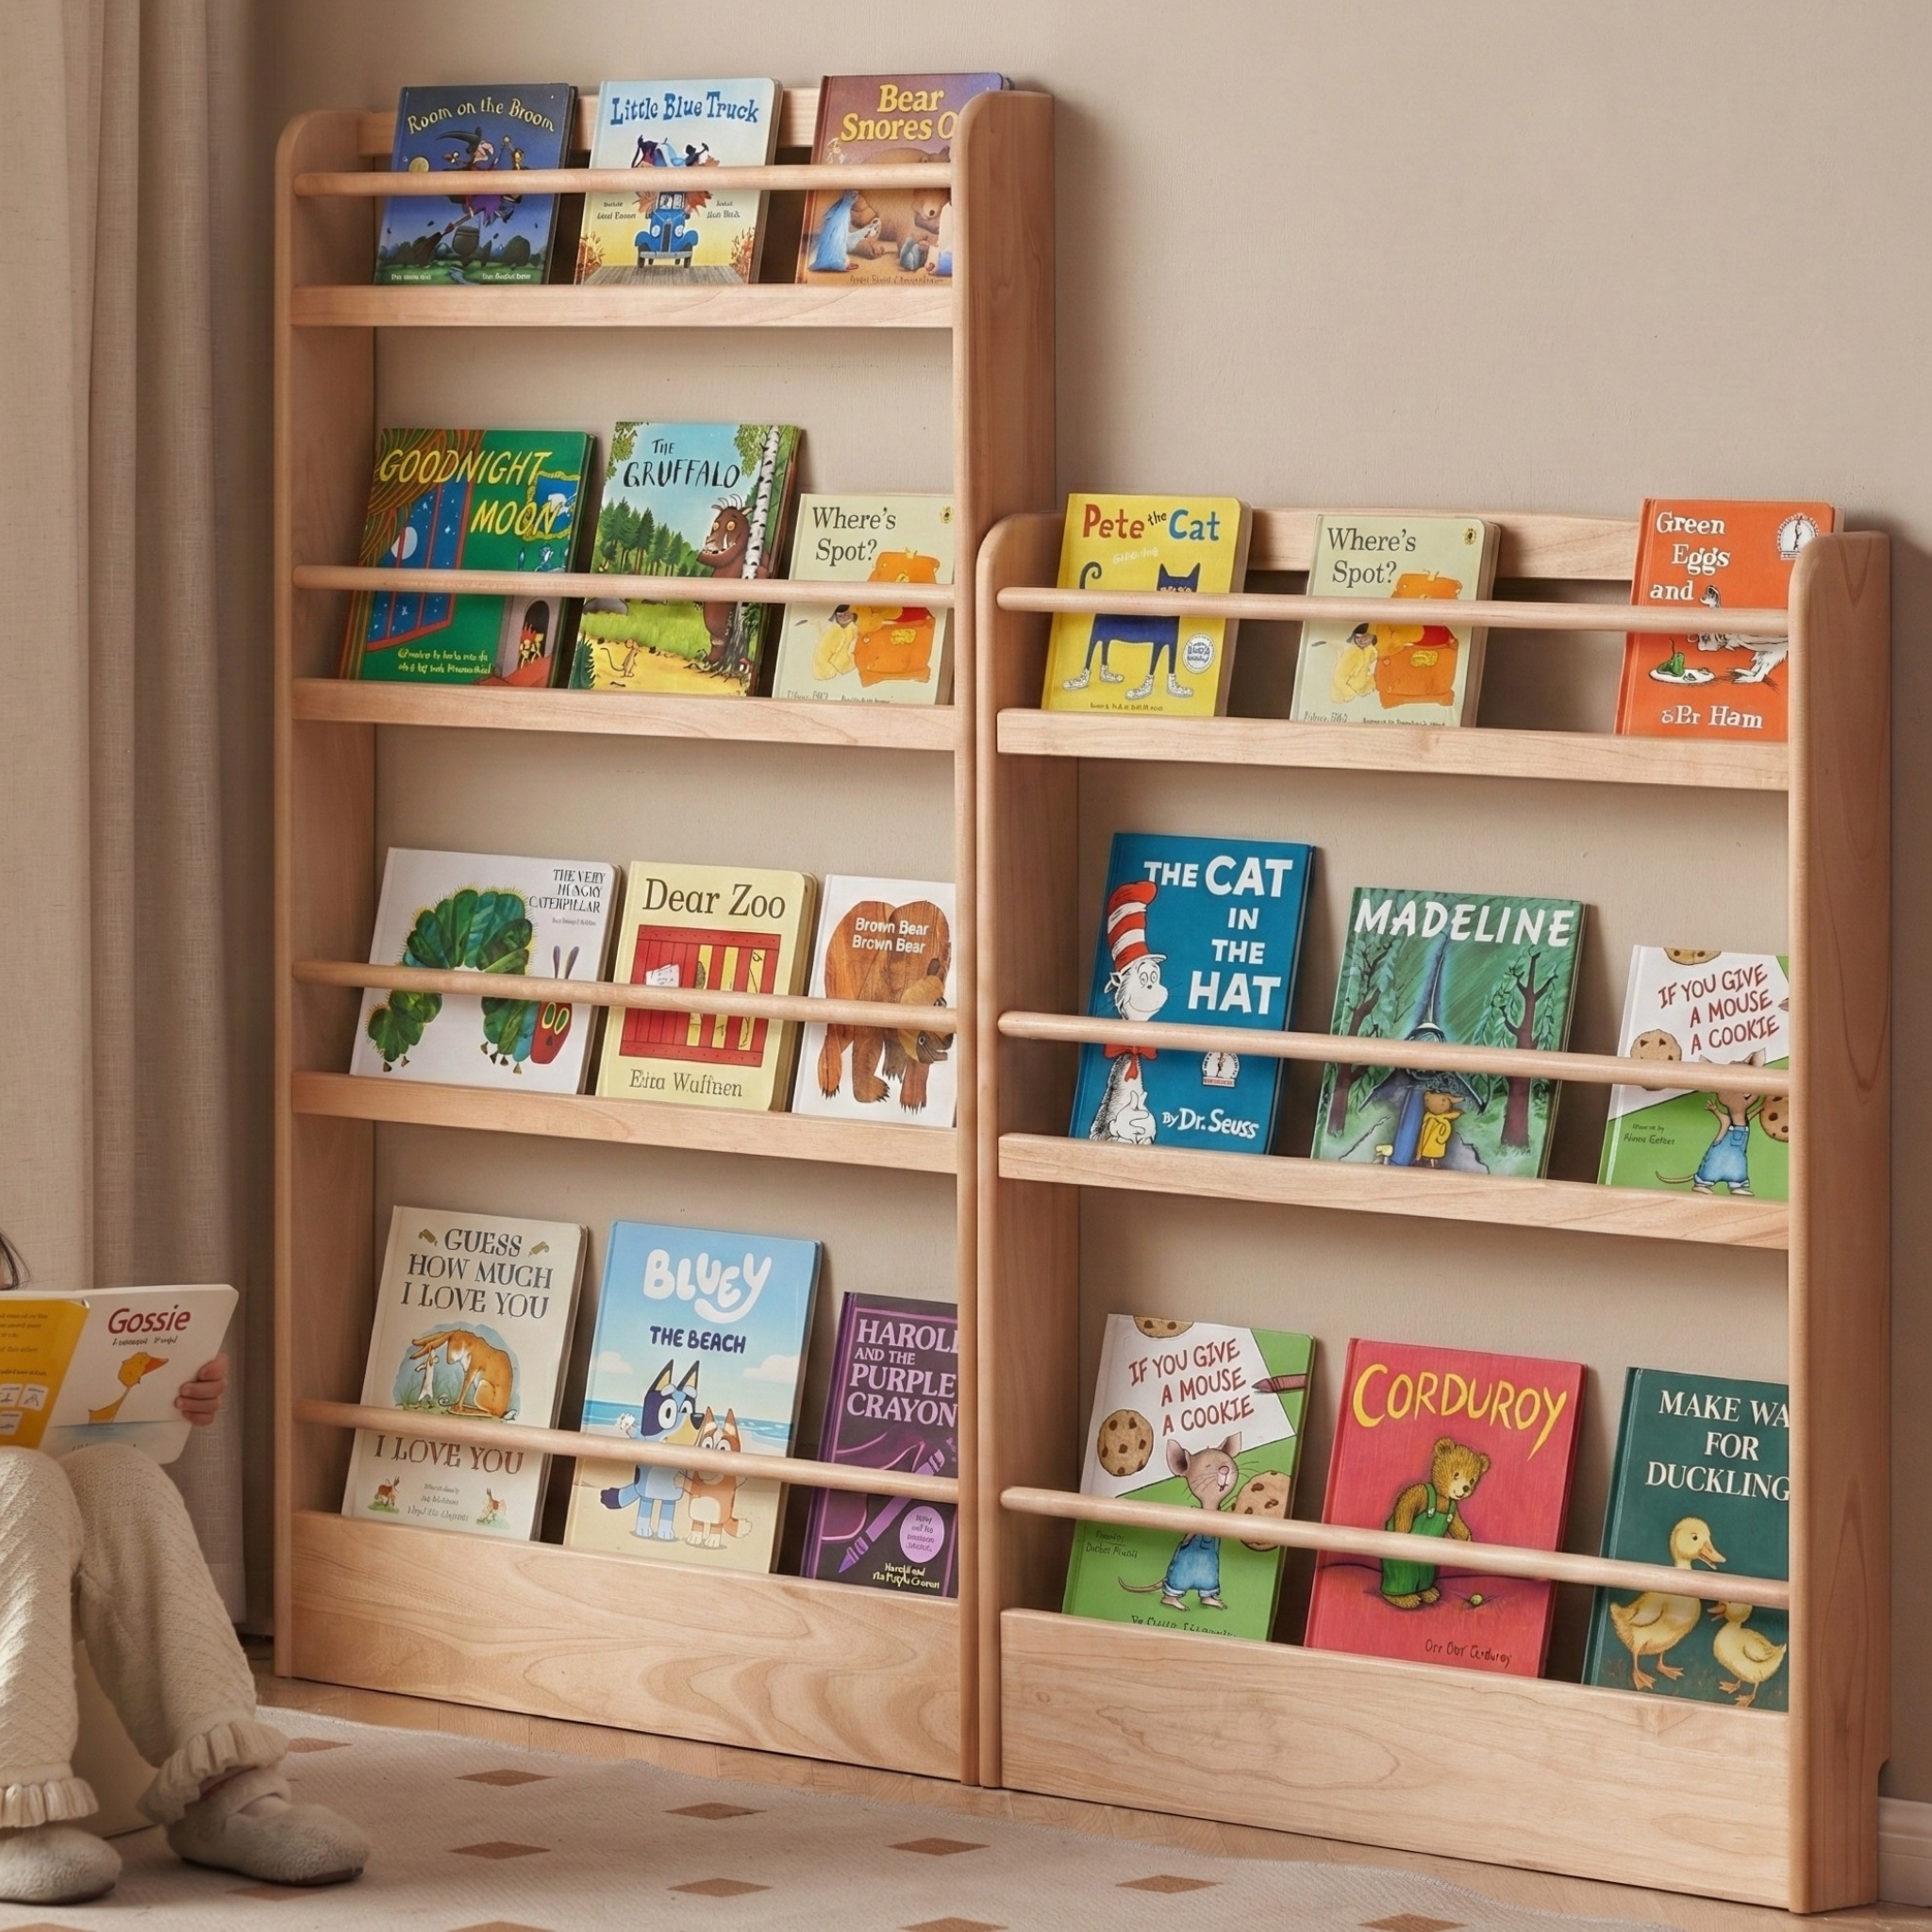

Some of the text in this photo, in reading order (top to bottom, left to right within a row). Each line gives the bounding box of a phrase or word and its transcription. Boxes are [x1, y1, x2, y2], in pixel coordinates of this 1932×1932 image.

[610, 92, 759, 125] Little Blue Truck
[876, 84, 944, 112] Bear
[408, 97, 555, 134] Room on the Broom
[841, 110, 959, 142] Snores O
[652, 438, 675, 455] THE
[380, 449, 553, 485] GOODNIGHT
[623, 458, 741, 489] GRUFFALO
[470, 500, 562, 536] MOON
[812, 507, 896, 529] Where's
[1082, 504, 1221, 541] Pete the Cat
[1657, 511, 1725, 535] Green
[815, 538, 877, 566] Spot?
[1327, 527, 1416, 552] Where's
[1332, 559, 1397, 589] Spot?
[1671, 543, 1731, 575] Eggs
[1650, 580, 1694, 601] and
[1707, 705, 1763, 729] Ham
[1143, 855, 1293, 898] THE CAT
[642, 878, 785, 919] Dear Zoo
[856, 917, 929, 937] Brown Bear
[1227, 907, 1258, 930] IN
[1354, 898, 1574, 947] MADELINE
[896, 938, 925, 954] Bear
[1211, 939, 1265, 965] THE
[1188, 970, 1281, 1015] HAT
[1658, 963, 1768, 1009] IF YOU GIVE
[1690, 989, 1773, 1028] A MOUSE
[1690, 1015, 1780, 1055] A COOKIE
[1161, 1108, 1259, 1140] By Dr. Seuss
[444, 1228, 523, 1257] GUESS
[407, 1253, 554, 1290] HOW MUCH
[642, 1248, 772, 1324] BLUEY
[400, 1281, 550, 1319] I LOVE YOU
[108, 1304, 192, 1334] Gossie
[649, 1325, 746, 1354] THE BEACH
[855, 1346, 916, 1365] AND THE
[1128, 1338, 1241, 1387] IF YOU GIVE
[849, 1363, 957, 1398] PURPLE
[1160, 1366, 1246, 1407] A MOUSE
[846, 1391, 958, 1427] CRAYON
[1162, 1394, 1255, 1436] A COOKIE
[1353, 1364, 1567, 1462] CORDUROY
[1658, 1390, 1790, 1428] MAKE WA
[375, 1434, 525, 1474] I LOVE YOU
[1704, 1431, 1759, 1461] FOR
[1645, 1461, 1790, 1502] DUCKLING
